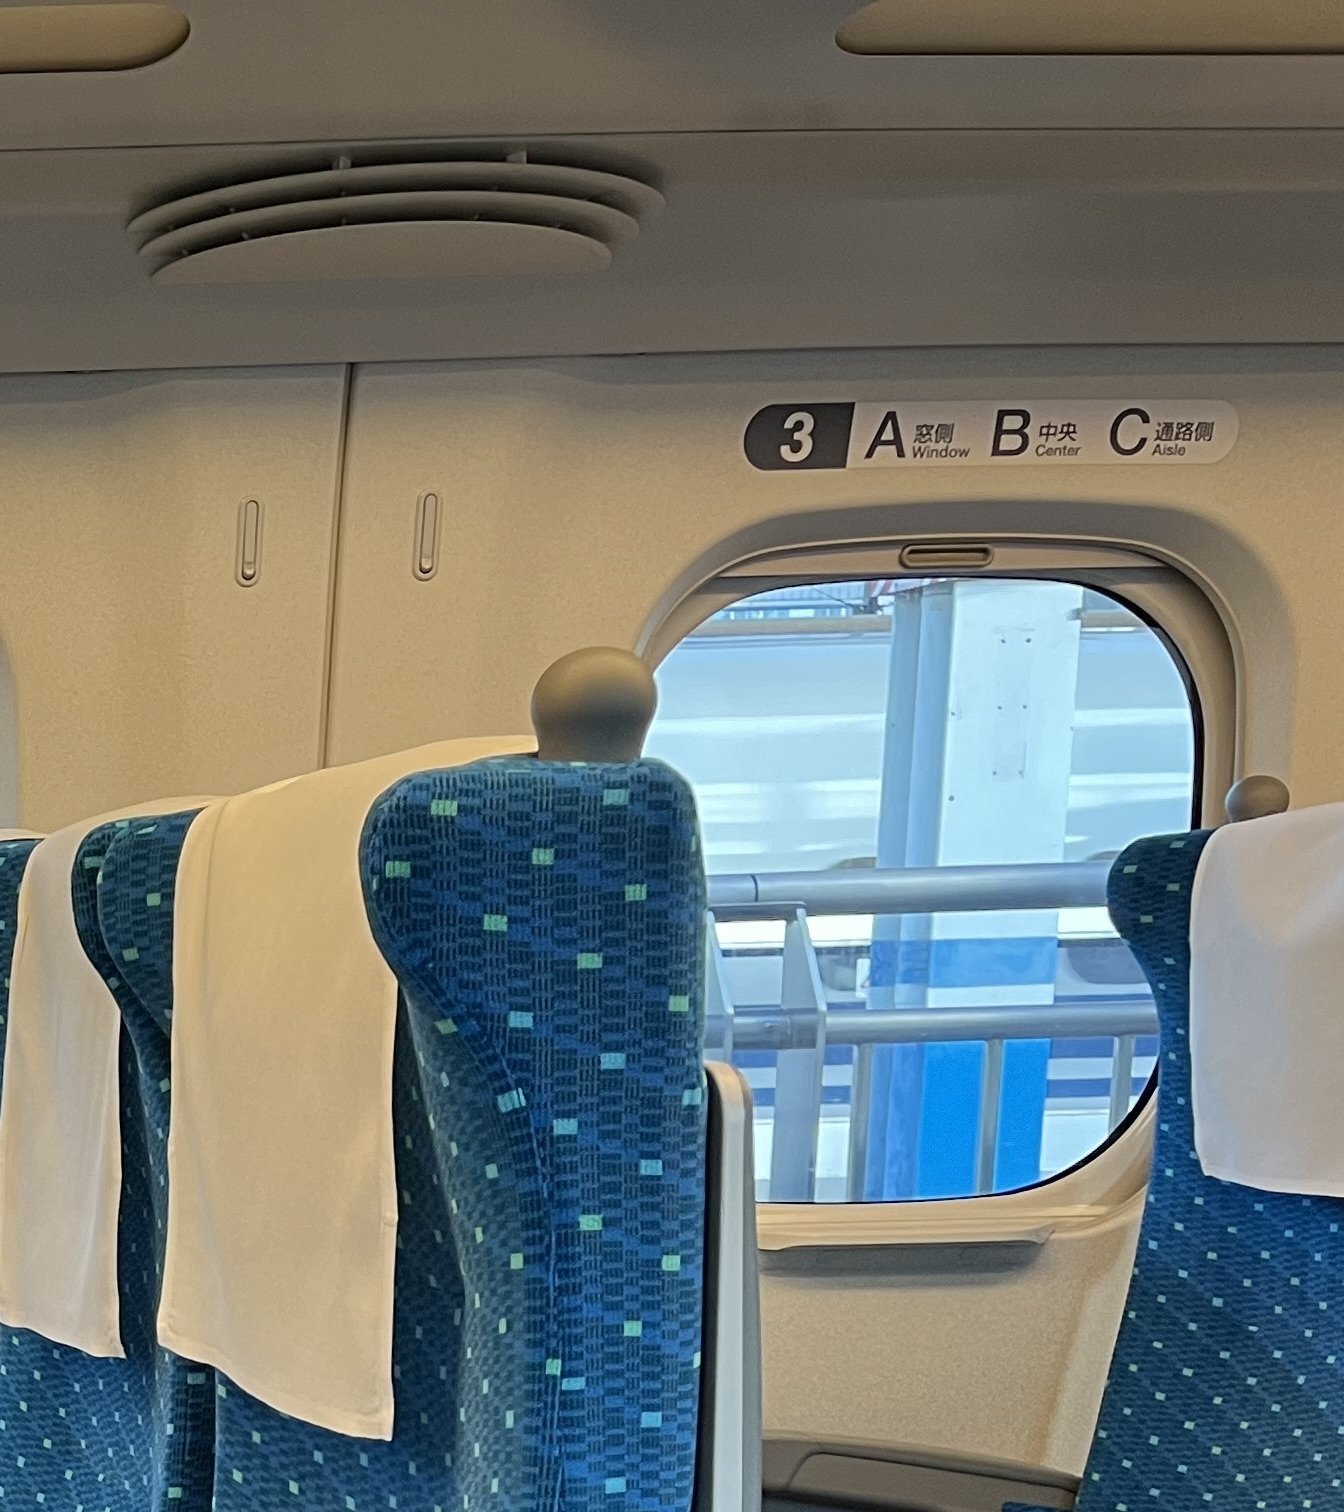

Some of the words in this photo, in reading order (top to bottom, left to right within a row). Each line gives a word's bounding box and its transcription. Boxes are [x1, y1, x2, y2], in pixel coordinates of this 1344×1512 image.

[779, 412, 815, 462] 3
[864, 411, 906, 460] A
[913, 423, 955, 444] 窓側
[990, 409, 1032, 457] B
[1038, 421, 1078, 443] 中央
[1109, 407, 1151, 456] C
[1155, 420, 1215, 442] 通路側
[912, 444, 971, 460] Window
[1035, 443, 1081, 458] Center
[1152, 443, 1186, 458] Aisle
